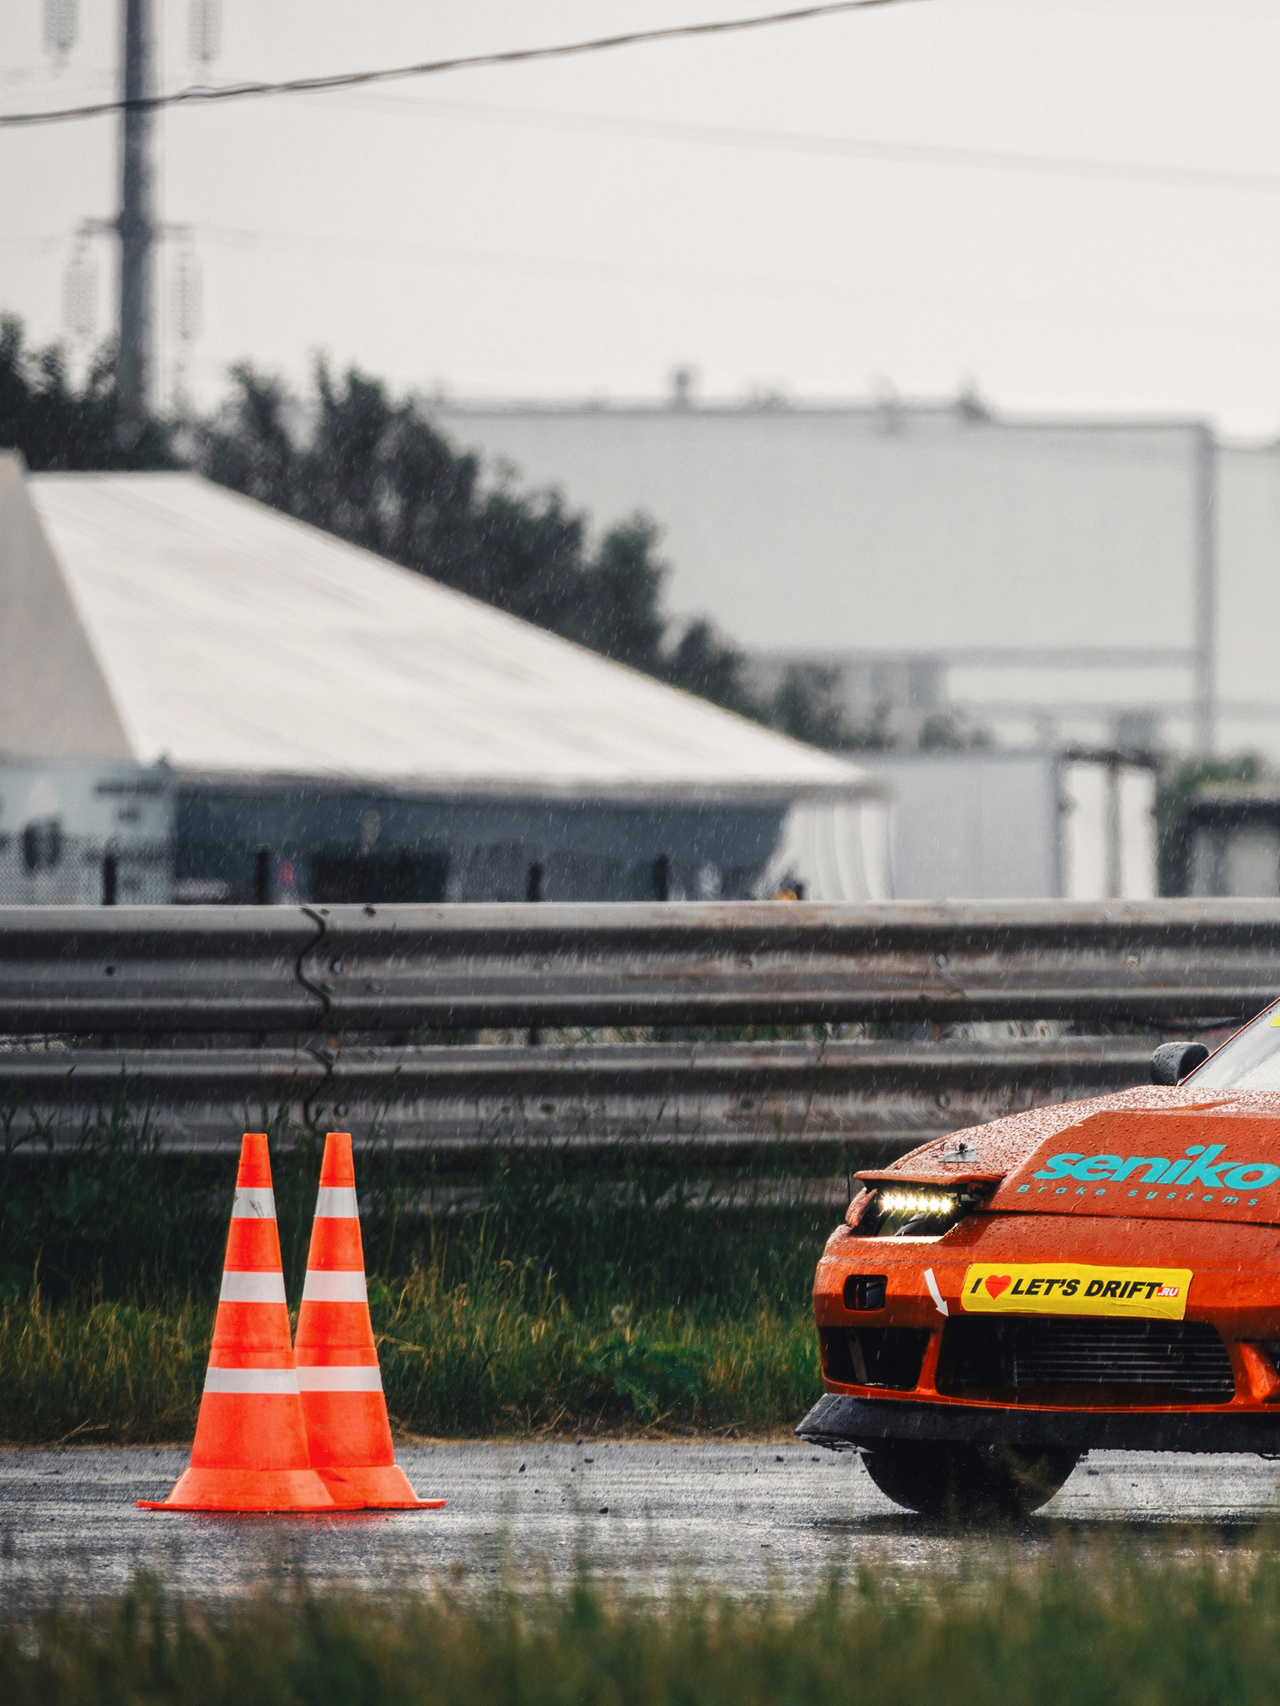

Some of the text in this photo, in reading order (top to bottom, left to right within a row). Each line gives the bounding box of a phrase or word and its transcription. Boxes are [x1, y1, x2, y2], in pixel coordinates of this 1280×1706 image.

[1032, 1144, 1280, 1190] seniko
[1017, 1184, 1259, 1206] Brake systems
[970, 1277, 983, 1294] I
[1010, 1277, 1079, 1296] LET'S
